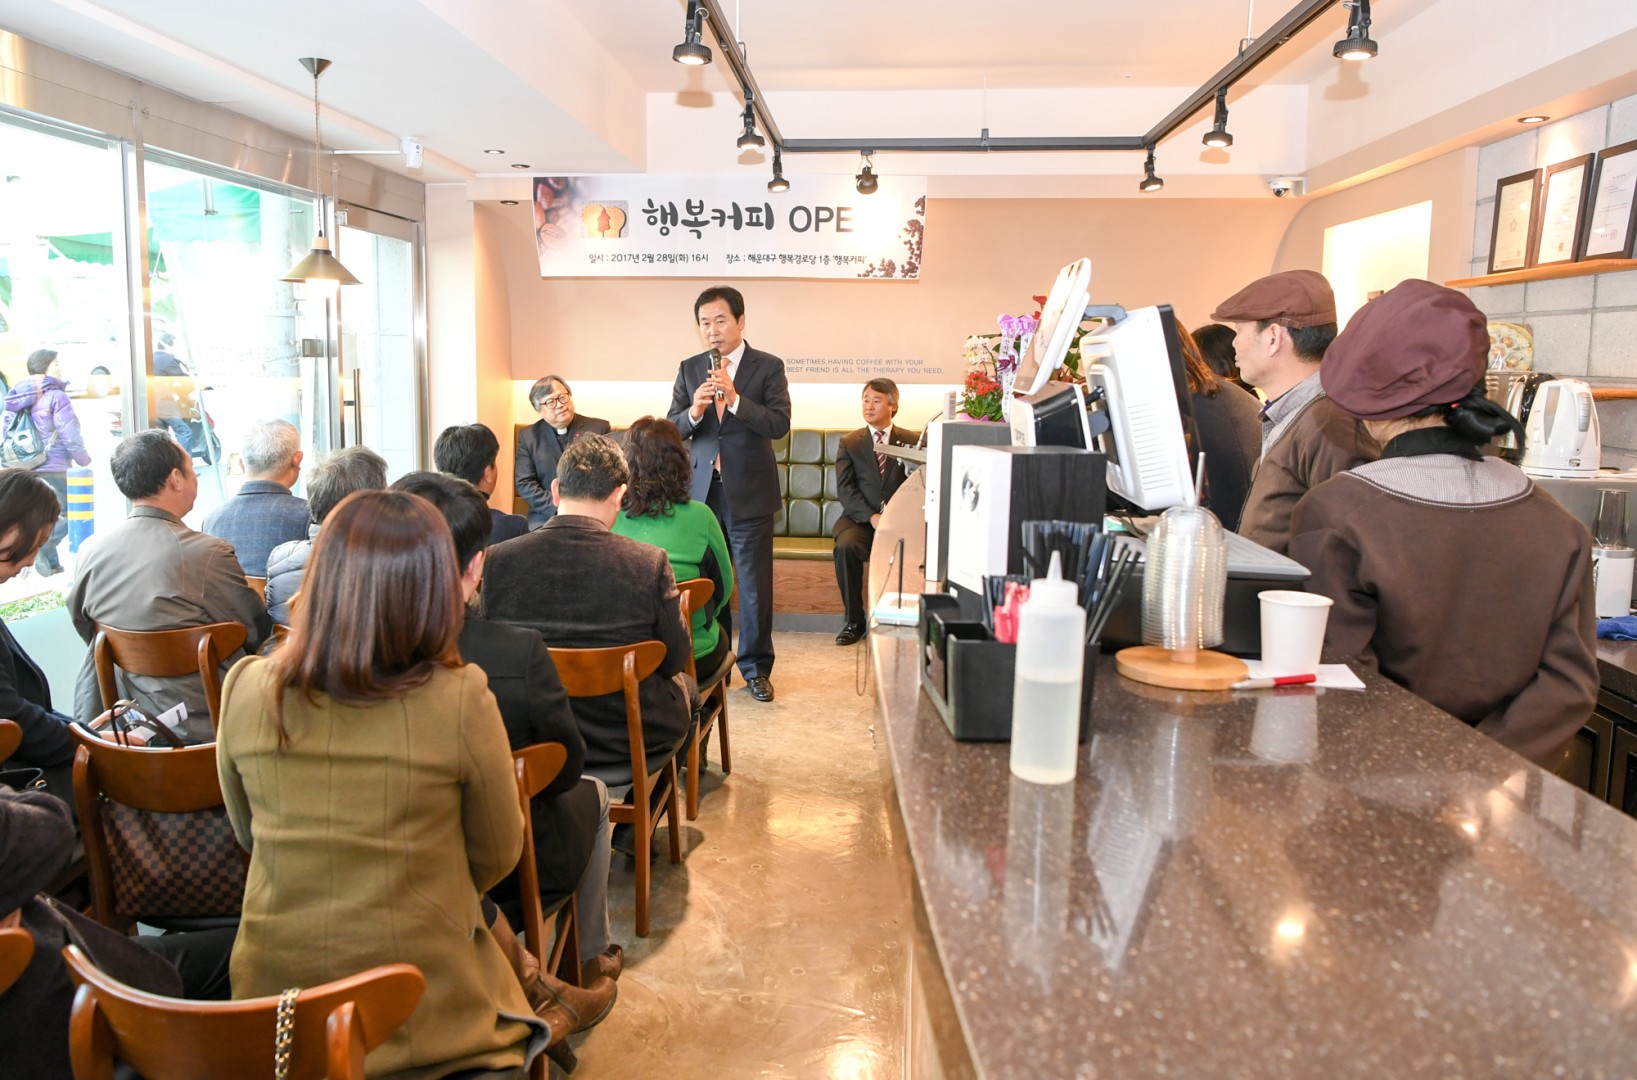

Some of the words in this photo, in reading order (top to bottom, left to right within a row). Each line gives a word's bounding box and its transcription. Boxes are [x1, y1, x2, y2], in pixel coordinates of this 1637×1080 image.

[641, 198, 775, 240] 행복커피
[788, 205, 857, 233] OPE
[589, 253, 604, 264] 일시
[611, 253, 640, 263] 2017년
[641, 253, 655, 263] 2월
[656, 253, 689, 264] 28일(화)
[691, 253, 709, 262] 16시
[726, 254, 741, 264] 장소
[747, 253, 777, 264] 해운대구
[778, 253, 817, 265] 행복경로당
[819, 255, 831, 265] 1층
[872, 367, 905, 375] THERAPY
[907, 367, 922, 375] YOU
